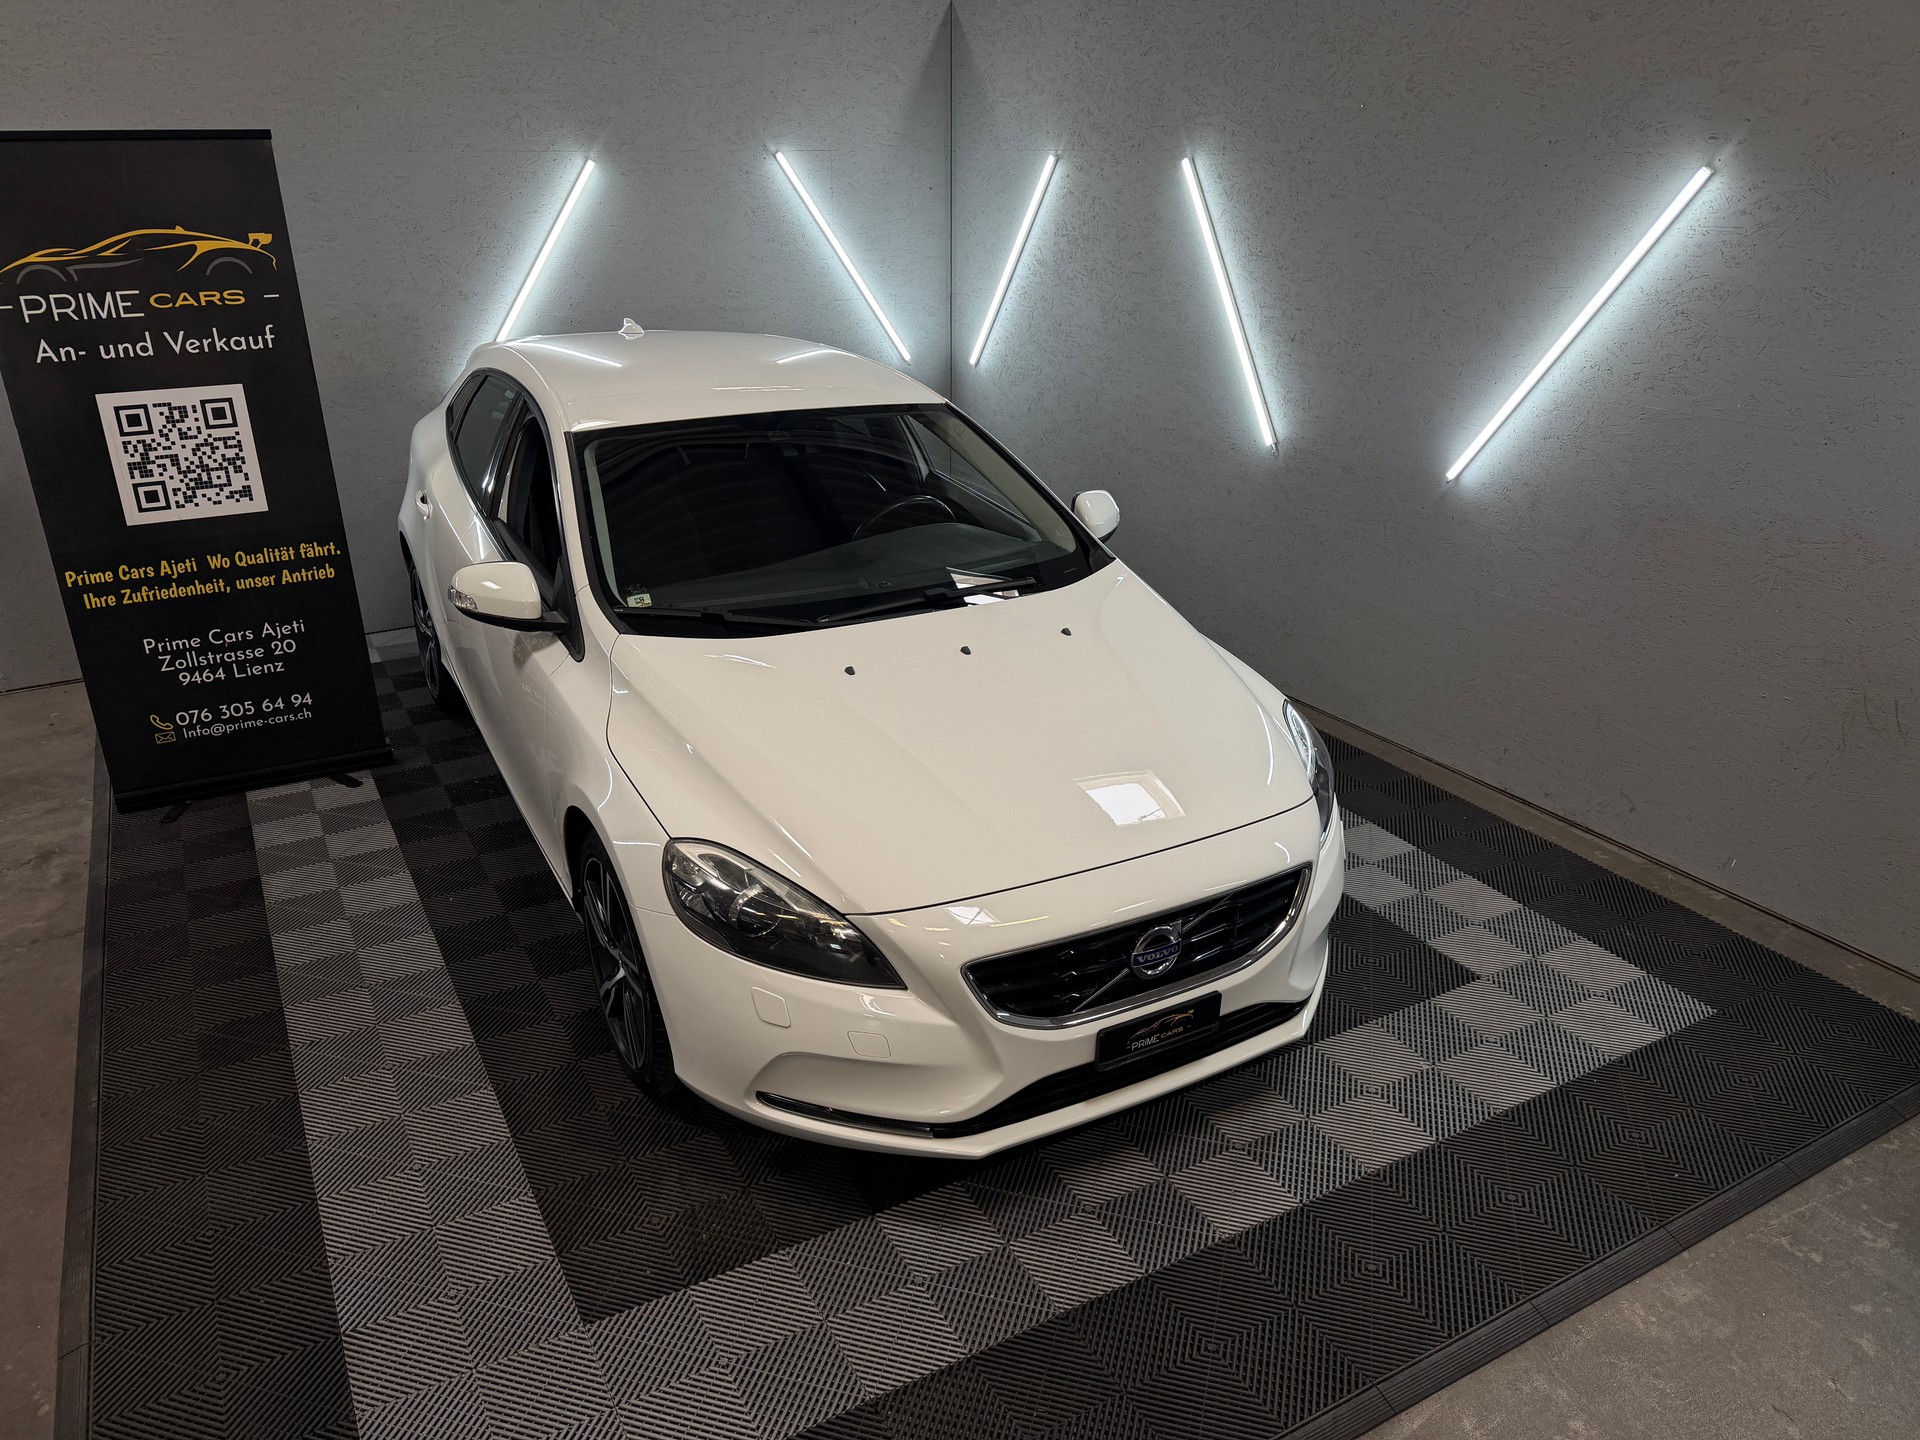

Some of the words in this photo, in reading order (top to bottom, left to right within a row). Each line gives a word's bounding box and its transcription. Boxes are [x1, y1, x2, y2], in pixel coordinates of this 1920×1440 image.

[18, 289, 145, 323] PRIME
[149, 289, 246, 309] CARS
[36, 338, 87, 364] An-
[98, 330, 154, 360] und
[162, 324, 275, 355] Verkauf
[64, 570, 114, 588] Prime
[118, 564, 155, 581] Cars
[160, 557, 198, 578] Ajeti
[206, 553, 231, 570] Wo
[234, 546, 295, 567] Qualität
[299, 541, 342, 559] fährt.
[83, 592, 117, 610] Ihre
[120, 578, 231, 605] Zufriedenheit,
[235, 574, 276, 590] unser
[281, 563, 335, 585] Antrieb
[142, 636, 202, 655] Prime
[208, 628, 254, 645] Cars
[261, 619, 306, 640] Ajeti
[157, 647, 265, 673] Zollstrasse
[271, 638, 297, 656] 20
[178, 666, 227, 686] 9464
[232, 660, 285, 678] Lienz
[175, 708, 213, 726] 076
[219, 700, 255, 719] 305
[262, 696, 285, 712] 64
[290, 692, 313, 708] 94
[182, 707, 313, 739] Info@prime-cars.ch
[1136, 945, 1179, 962] VOLVO
[1131, 1033, 1160, 1050] PRIME
[1160, 1025, 1184, 1038] CARS
